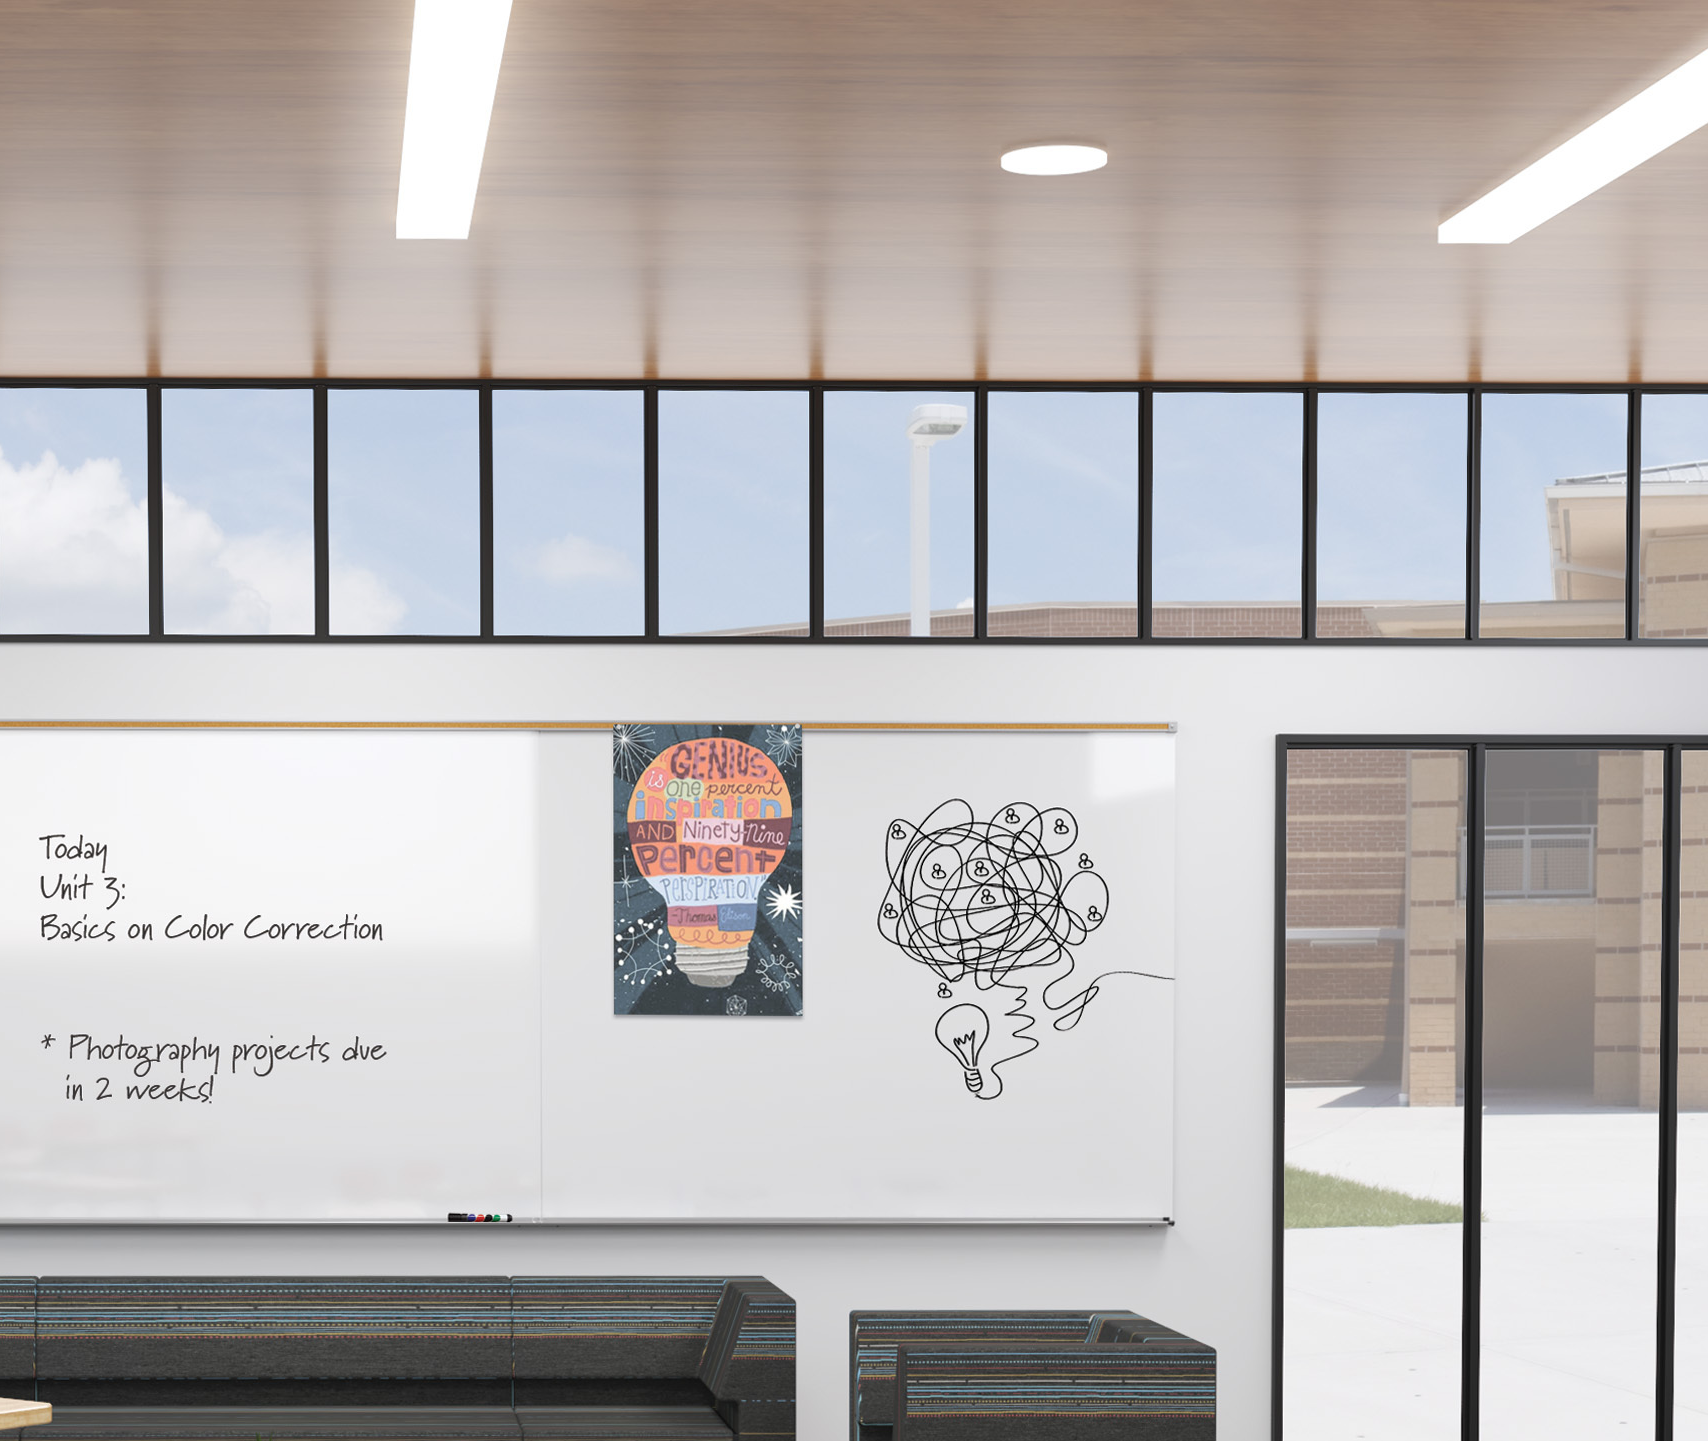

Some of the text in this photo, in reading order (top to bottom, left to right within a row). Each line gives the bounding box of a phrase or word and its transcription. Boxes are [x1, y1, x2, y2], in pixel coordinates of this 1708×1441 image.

[647, 769, 665, 788] is
[666, 773, 784, 798] one percent
[635, 790, 782, 828] inspiration
[636, 822, 675, 841] AND
[39, 834, 108, 873] Today
[40, 873, 126, 910] Unit 3:
[40, 914, 383, 942] Basics on Color Correction
[69, 1033, 387, 1077] Photography projects due
[66, 1074, 213, 1104] in 2 weeks!
